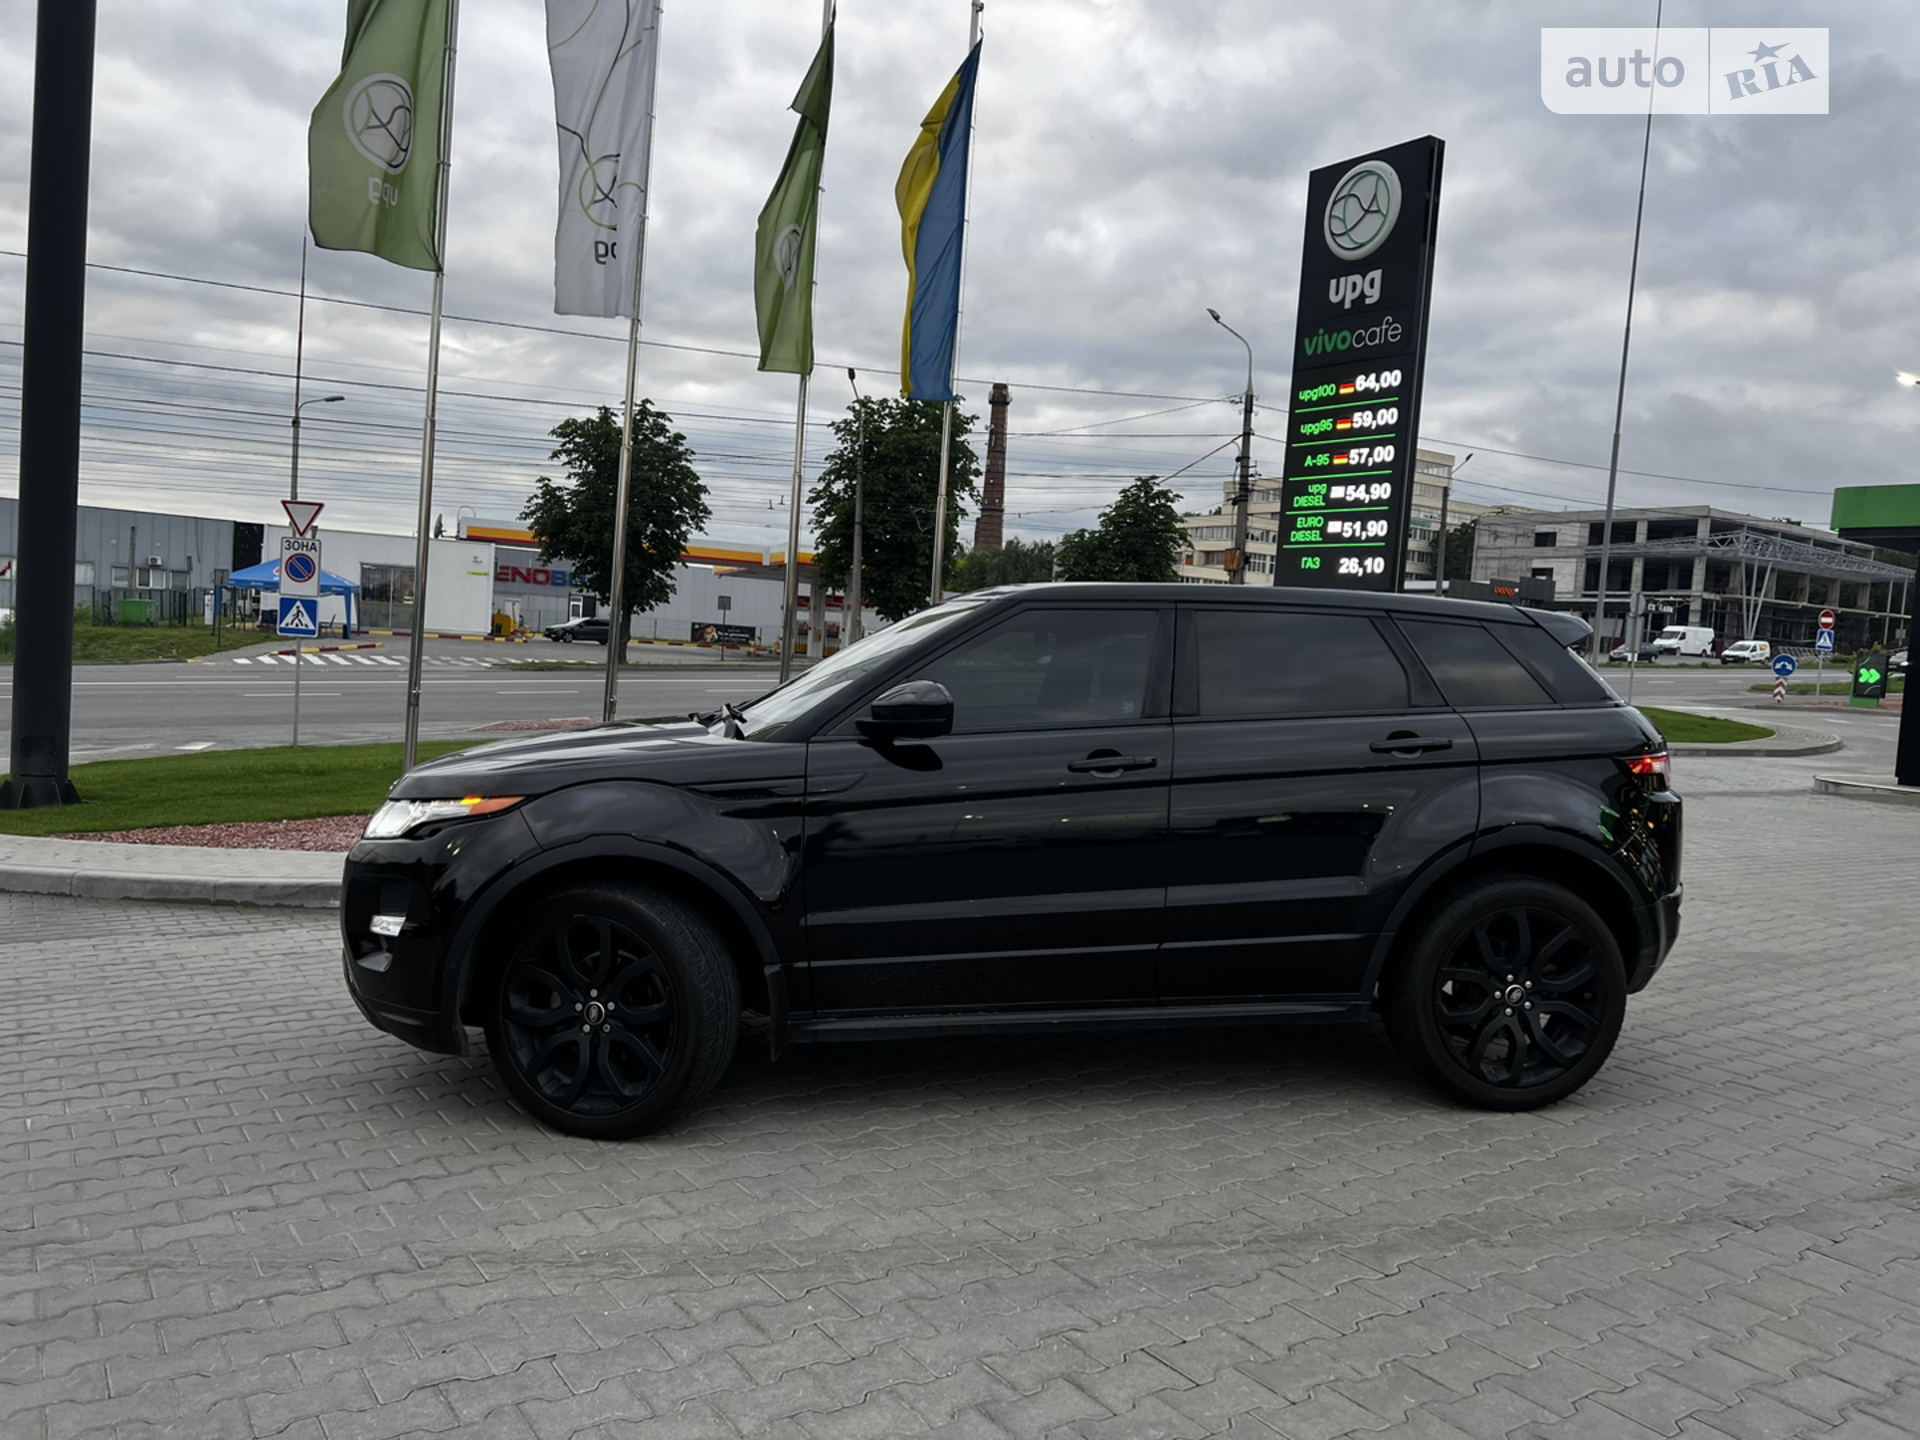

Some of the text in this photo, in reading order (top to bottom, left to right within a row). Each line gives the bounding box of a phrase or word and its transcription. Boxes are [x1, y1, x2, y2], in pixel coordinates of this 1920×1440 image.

[1328, 269, 1383, 310] upg
[1299, 369, 1402, 402] upg100 64,00
[1300, 407, 1398, 435] upg95 59,00
[1349, 445, 1395, 467] 57,00
[1293, 495, 1326, 507] DIESEL
[1308, 482, 1392, 504] upg 54,90
[1290, 530, 1323, 542] DIESEL
[1296, 516, 1388, 541] EURO 51,90
[284, 540, 318, 552] ЗОНА
[1301, 557, 1385, 577] ГАЗ 26,10
